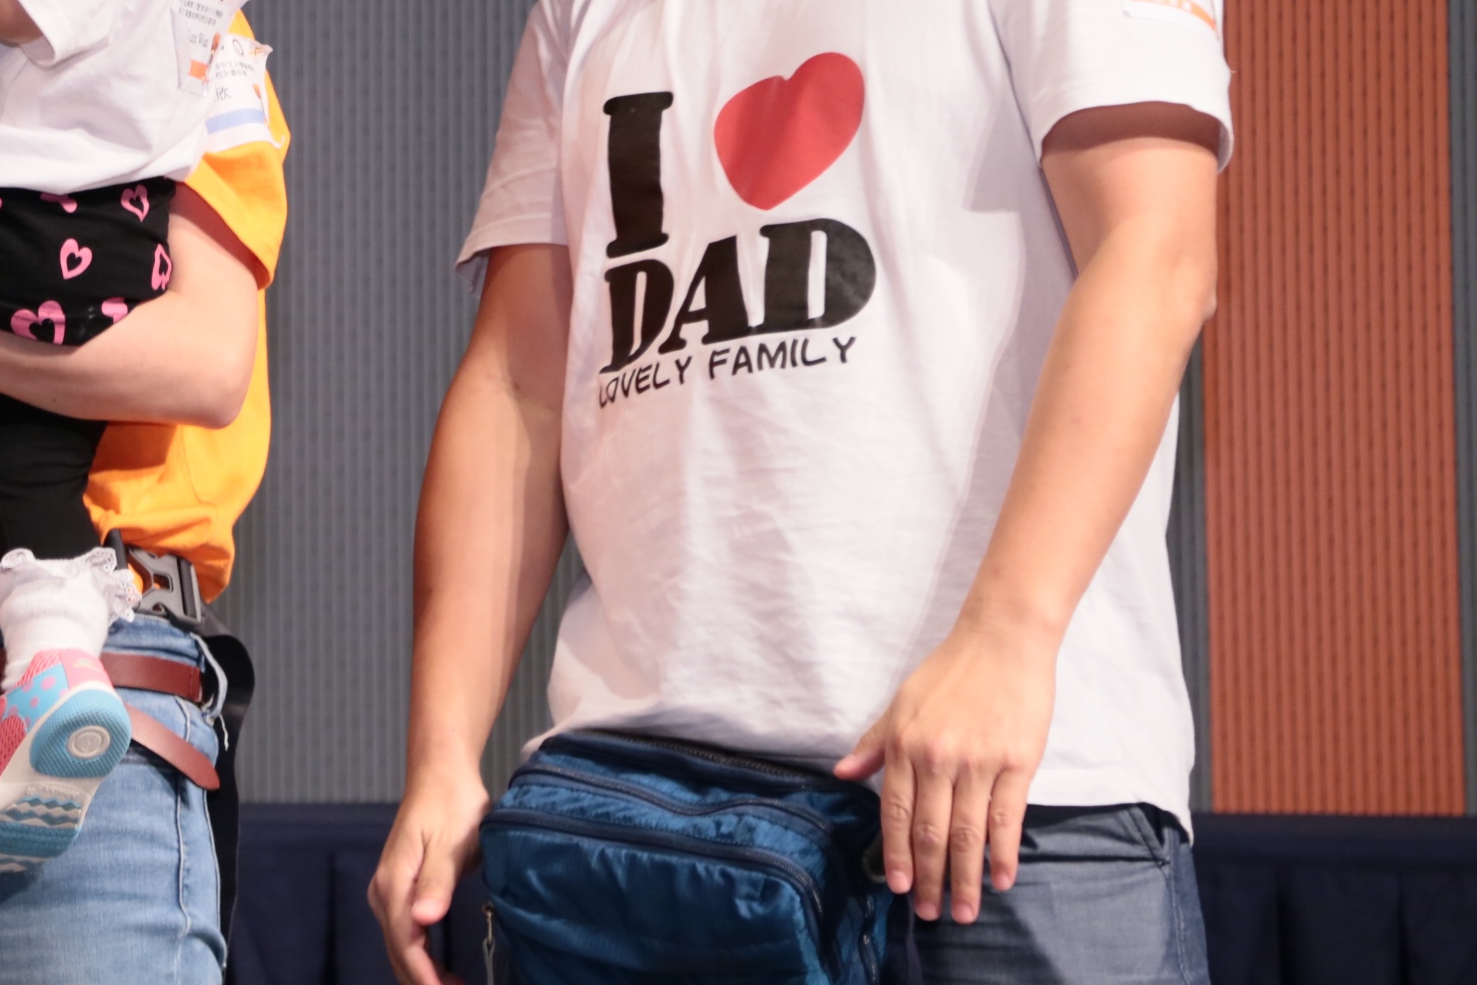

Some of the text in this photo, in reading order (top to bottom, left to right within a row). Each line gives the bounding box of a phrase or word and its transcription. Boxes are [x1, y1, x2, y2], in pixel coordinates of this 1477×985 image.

[603, 91, 673, 259] I
[598, 336, 856, 409] LOVELY FAMILY
[599, 218, 876, 374] DAD
